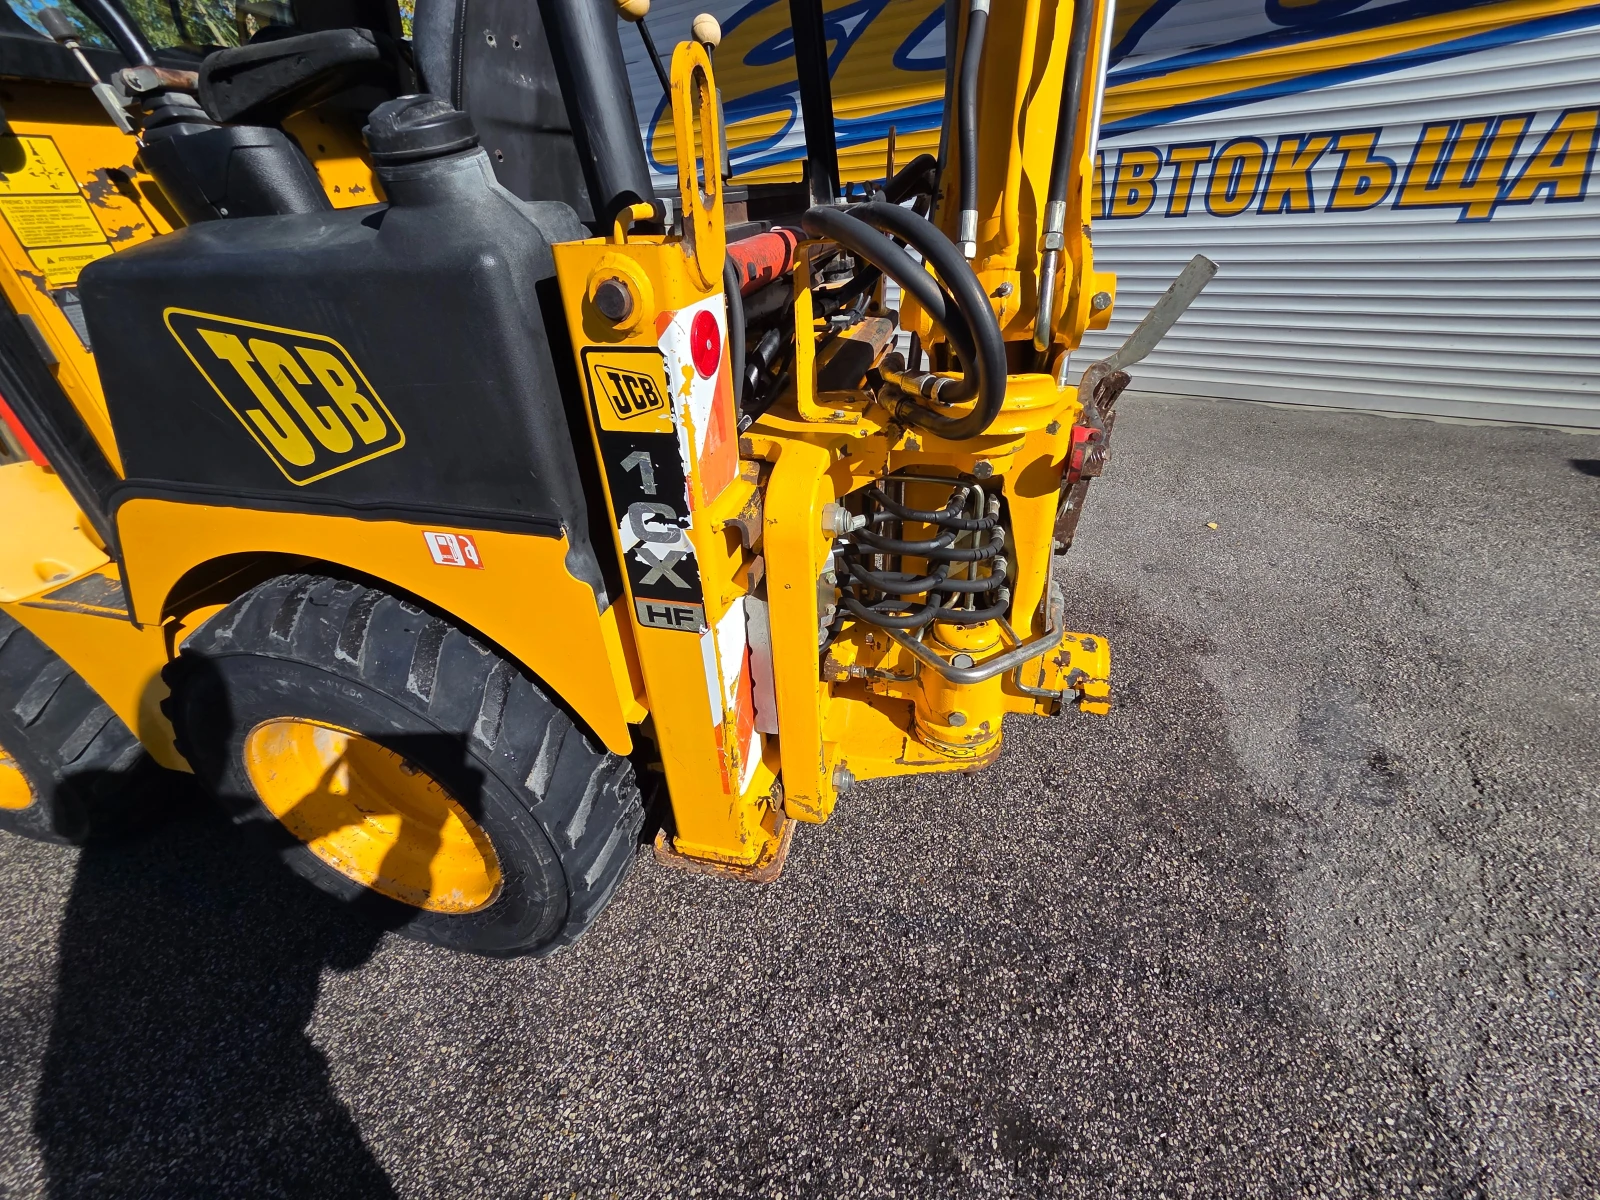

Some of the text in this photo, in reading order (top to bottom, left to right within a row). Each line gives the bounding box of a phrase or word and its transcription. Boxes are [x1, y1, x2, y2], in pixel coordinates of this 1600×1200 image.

[196, 328, 387, 467] JCB
[606, 371, 659, 414] JCB
[646, 605, 694, 625] HF
